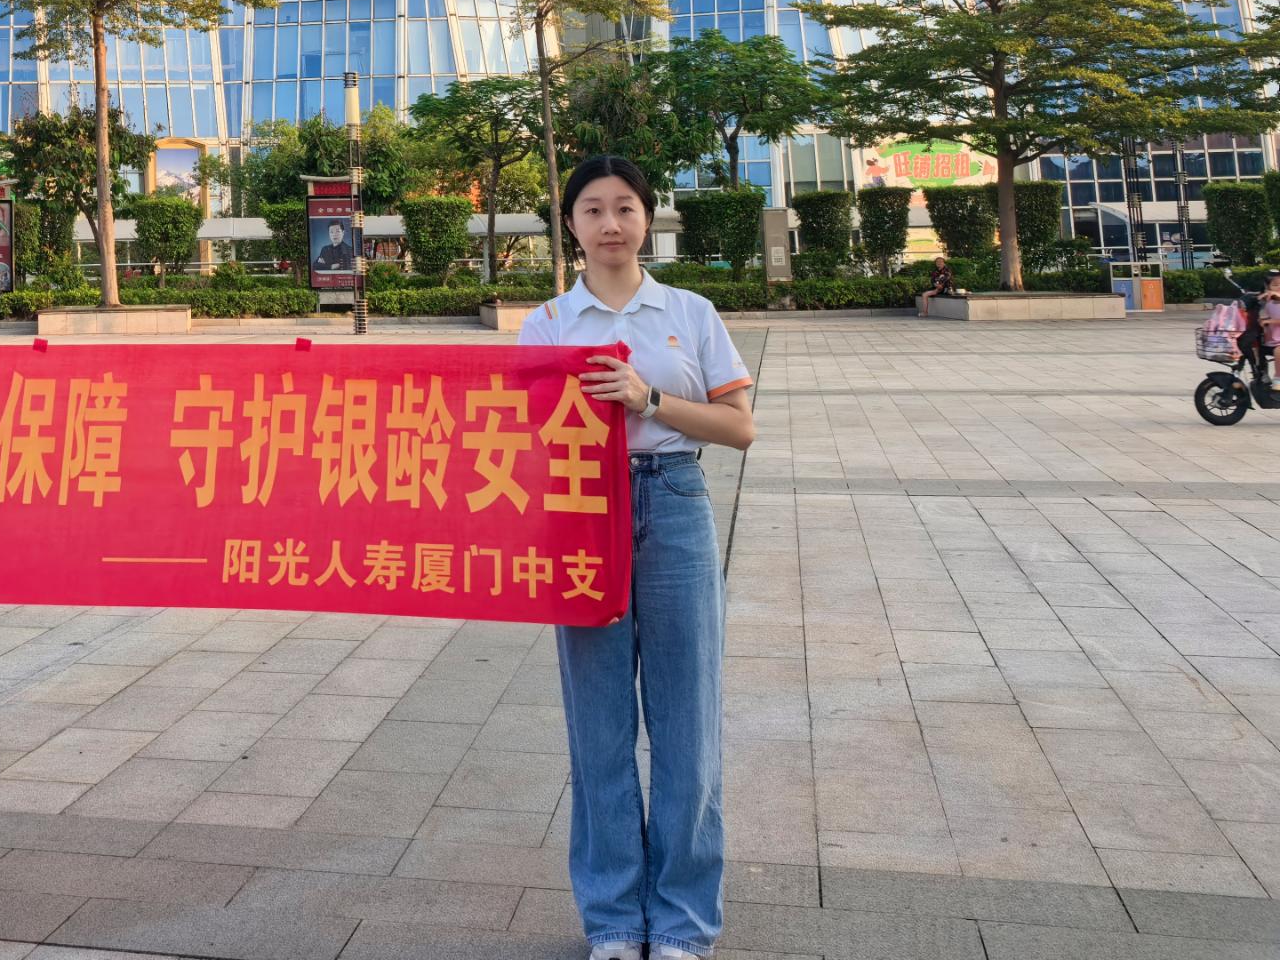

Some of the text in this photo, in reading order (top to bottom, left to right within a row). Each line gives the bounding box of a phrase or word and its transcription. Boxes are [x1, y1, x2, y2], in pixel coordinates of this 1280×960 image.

[893, 151, 971, 179] 旺铺招租
[170, 373, 610, 515] 守护银龄安全
